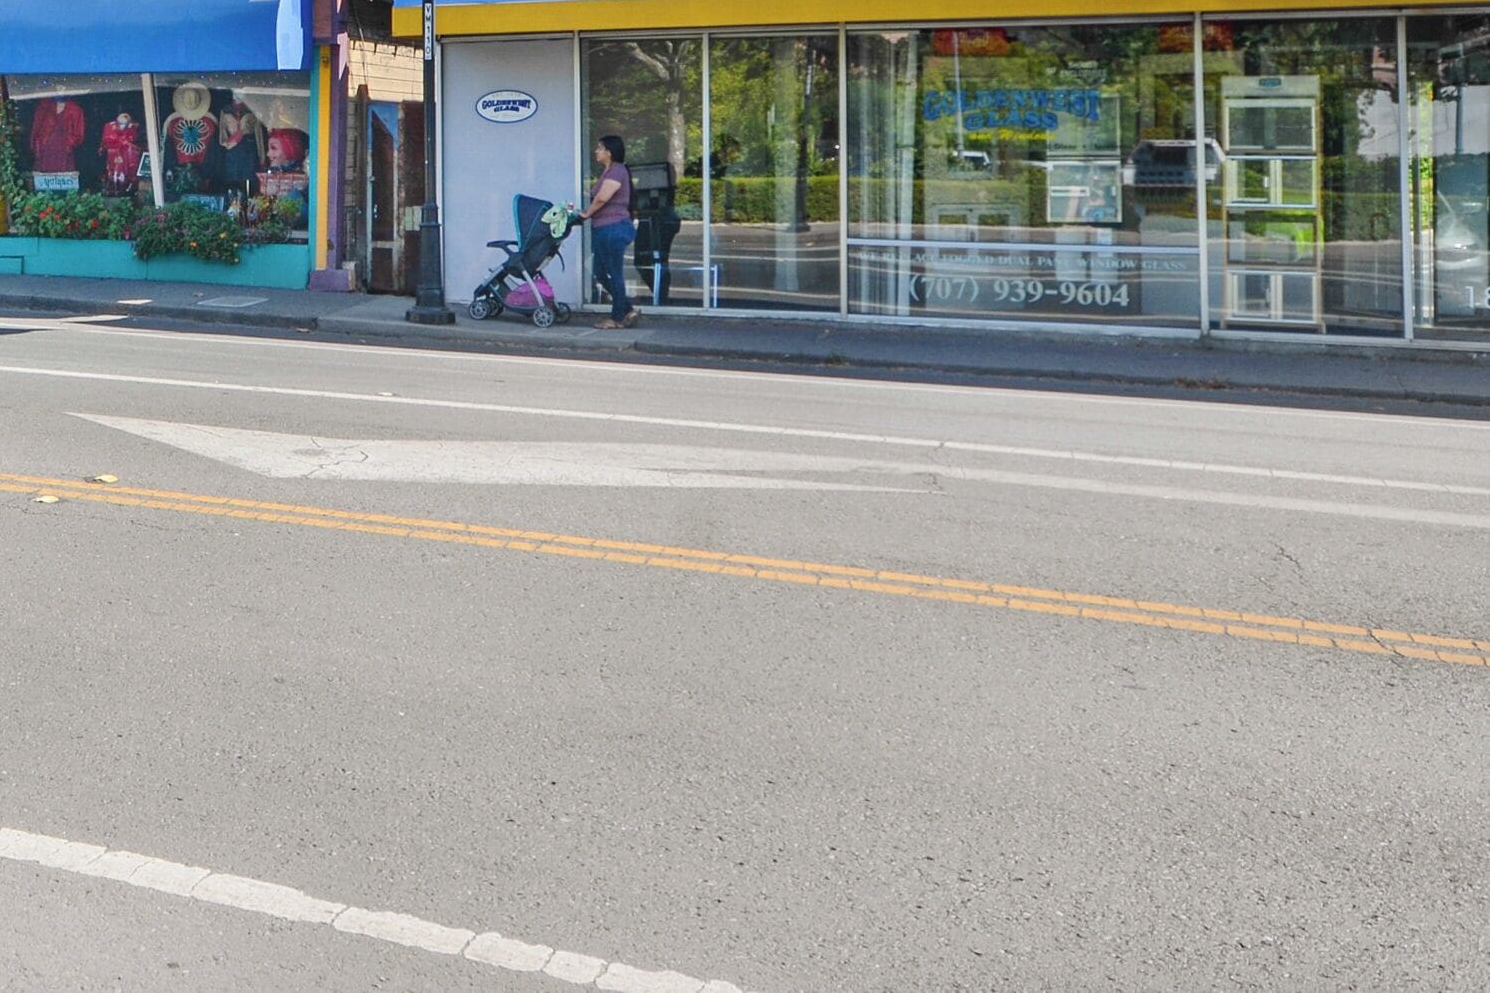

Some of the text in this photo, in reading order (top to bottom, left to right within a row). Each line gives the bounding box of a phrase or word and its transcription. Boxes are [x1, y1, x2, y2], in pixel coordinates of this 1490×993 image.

[923, 89, 1102, 121] GOLDENWEST
[963, 109, 1059, 131] GLASS
[910, 274, 1131, 307] (707) 939-9604
